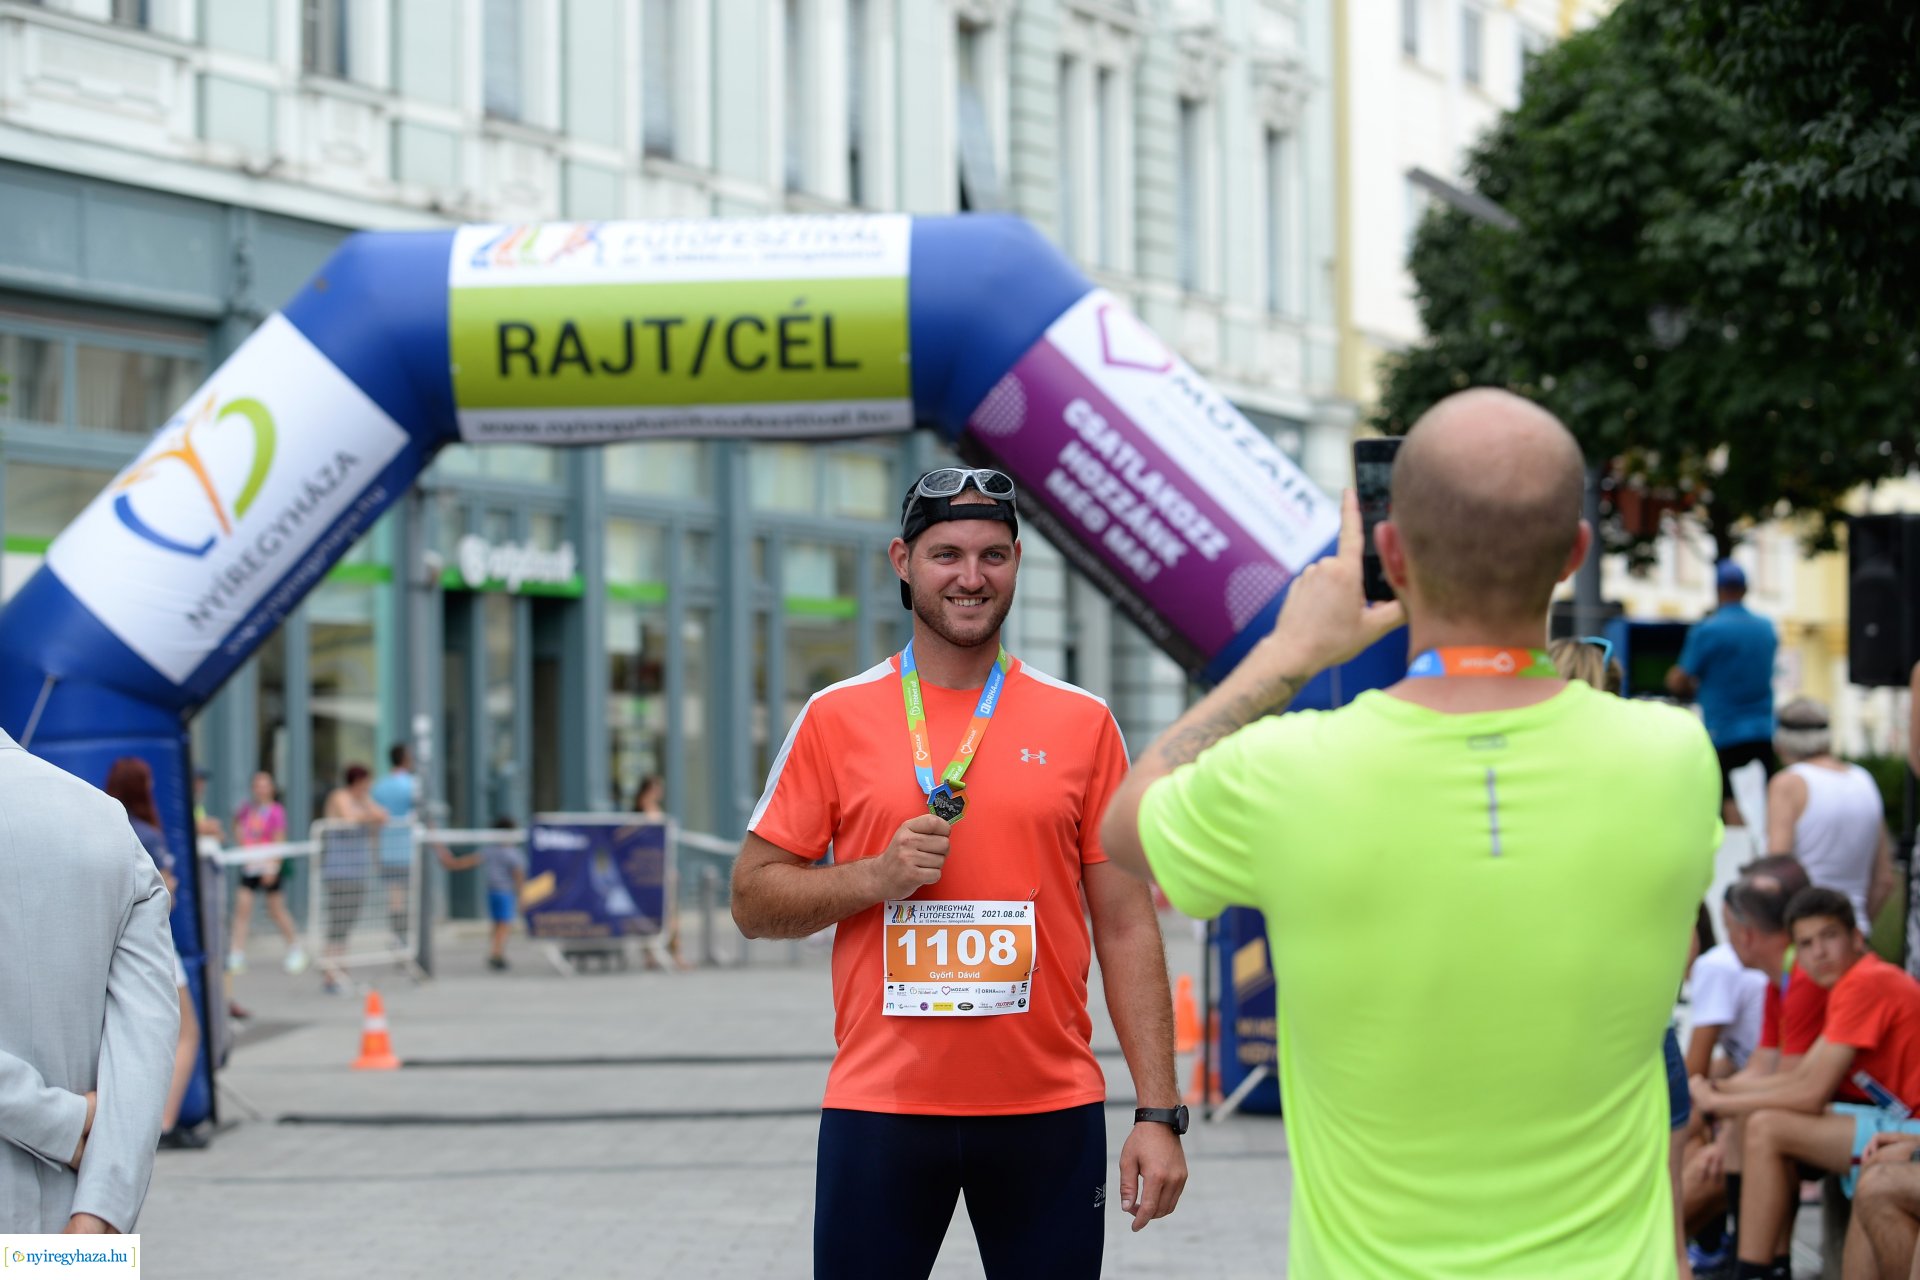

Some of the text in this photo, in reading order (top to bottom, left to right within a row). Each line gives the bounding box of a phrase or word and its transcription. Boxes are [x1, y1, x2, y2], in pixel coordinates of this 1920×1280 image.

[497, 297, 861, 379] RAJT/CÉL
[1058, 440, 1187, 568] HOZZÁNK
[1062, 397, 1230, 562] CSATLAKOZZ
[186, 447, 361, 634] NYÍREGYHÁZA
[1044, 467, 1107, 534] MÉG
[1102, 522, 1162, 583] MA!
[919, 911, 975, 919] FUTÓFESZTIVÁL
[926, 904, 974, 912] NYÍREGYHÁZI
[981, 910, 1027, 918] 2021.08.08.
[897, 929, 1018, 966] 1108
[929, 971, 980, 979] Győrfi Dávid
